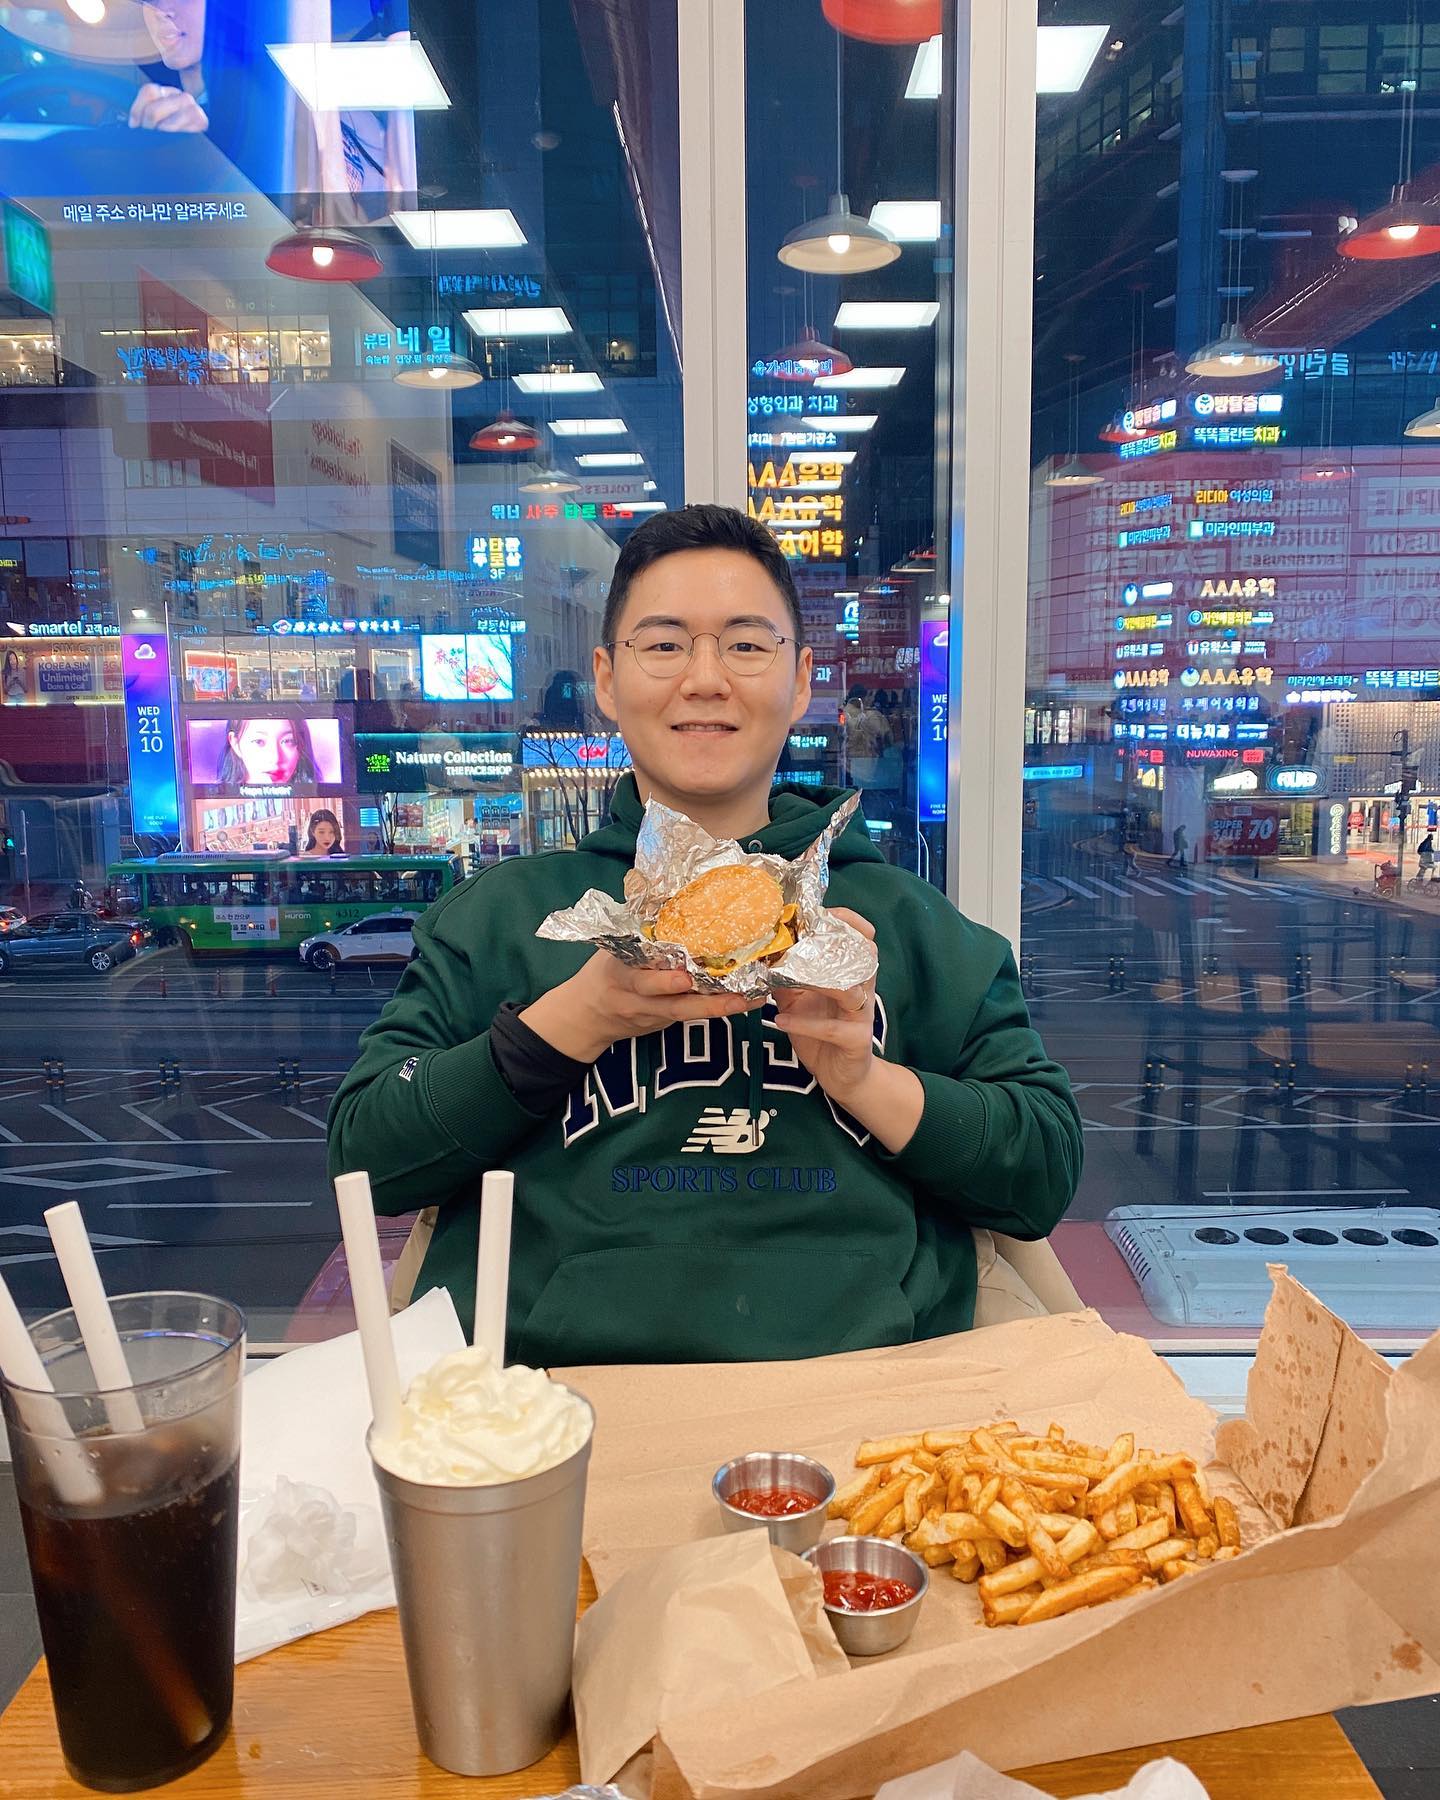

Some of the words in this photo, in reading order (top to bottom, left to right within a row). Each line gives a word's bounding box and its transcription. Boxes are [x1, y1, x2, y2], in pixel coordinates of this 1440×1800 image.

[63, 204, 93, 223] 메일
[96, 204, 125, 222] 주소
[127, 203, 171, 221] 하나만
[174, 202, 248, 220] 알려주세요
[363, 333, 391, 350] 뷰티
[396, 326, 450, 352] 네일
[748, 396, 803, 413] 성형외과
[808, 395, 838, 412] 치과
[1195, 426, 1280, 443] 똑똑플란트치과
[1195, 490, 1228, 503] 리디아
[1229, 489, 1273, 502] 여성의원
[563, 503, 597, 520] 타로
[1205, 521, 1275, 537] 미라인피부과
[490, 568, 506, 580] 3F
[1200, 577, 1276, 597] AAA유학
[28, 620, 82, 636] smartel
[42, 673, 88, 682] Unlimited
[1199, 667, 1274, 686] AAA유학
[932, 694, 948, 703] WE
[137, 706, 160, 715] WED
[138, 718, 161, 734] 21
[141, 736, 163, 752] 10
[395, 751, 442, 764] Nature
[443, 749, 512, 764] Collection
[1186, 750, 1239, 758] NUWAXING
[1213, 819, 1243, 829] SUPER
[611, 1166, 738, 1193] SPORTS
[746, 1166, 837, 1193] CLUB
